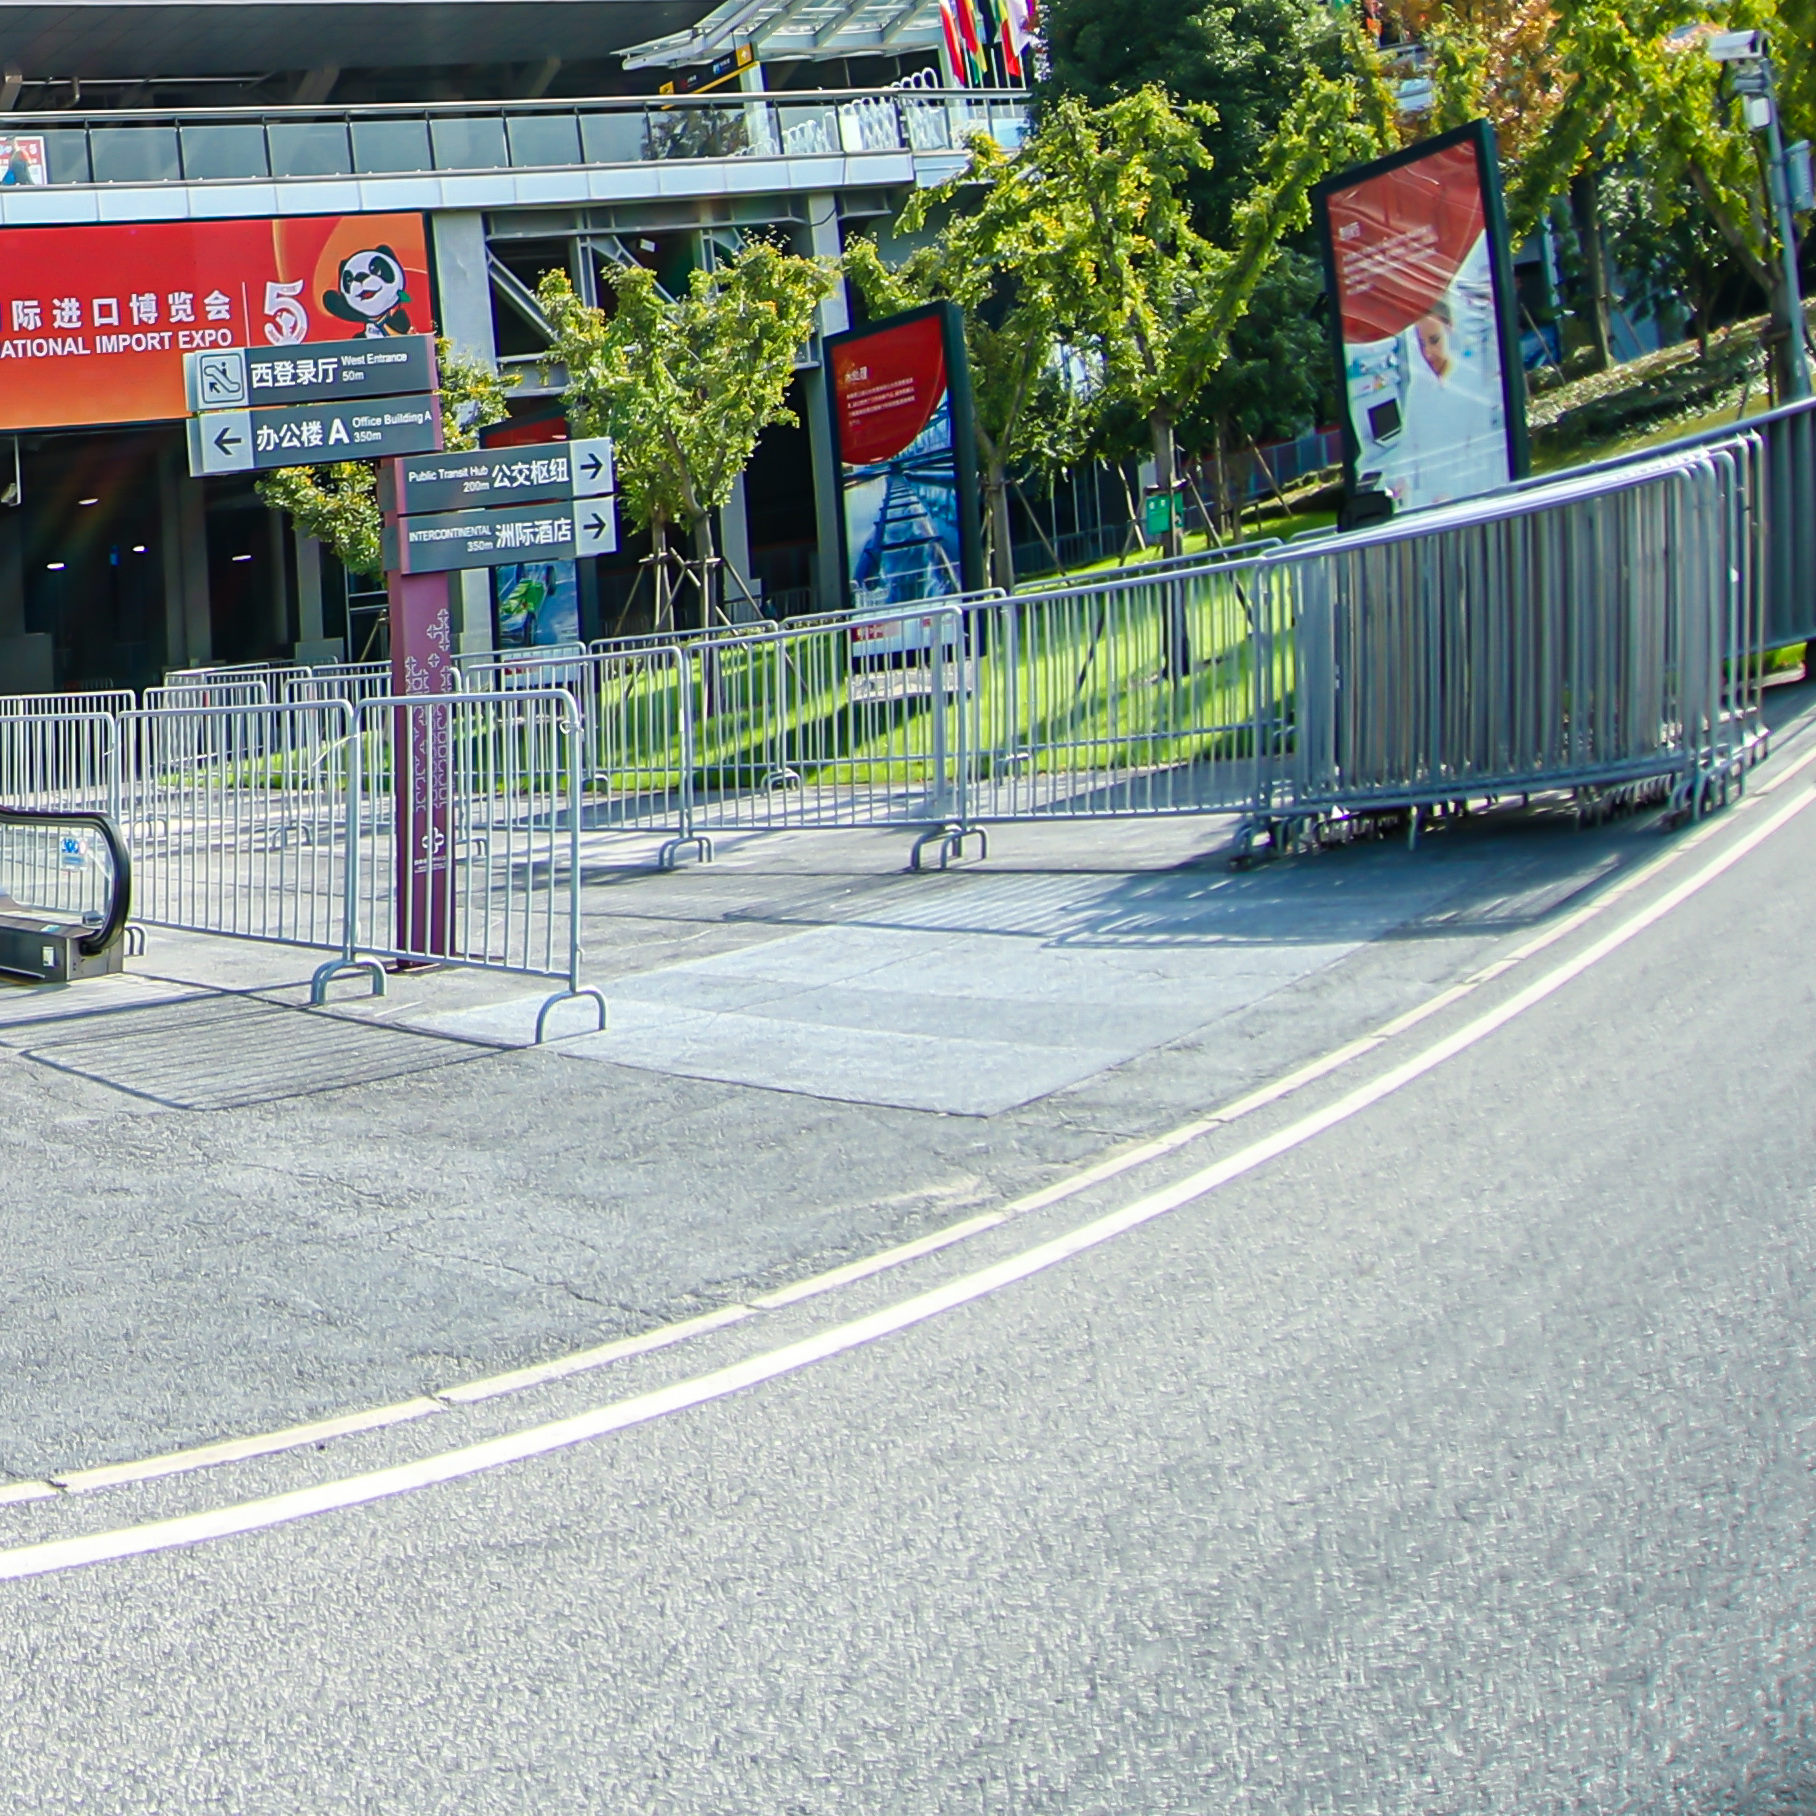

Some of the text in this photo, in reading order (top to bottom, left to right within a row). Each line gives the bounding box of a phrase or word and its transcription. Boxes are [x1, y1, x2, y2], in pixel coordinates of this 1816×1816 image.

[95, 332, 173, 354] IMPORT
[178, 328, 232, 349] EXPO
[341, 352, 408, 367] West Entrance
[251, 357, 338, 389] 西登录厅
[342, 370, 365, 382] 50m
[352, 410, 433, 428] Office Building A
[256, 417, 350, 452] 办公楼 A
[353, 430, 382, 443] 350m
[408, 465, 489, 482] Public Transit Hub
[492, 457, 570, 488] 公交枢纽
[463, 481, 490, 493] 200m
[409, 524, 492, 542] INTERCONTINENTAL
[495, 517, 572, 548] 洲际酒店
[467, 540, 493, 552] 350m
